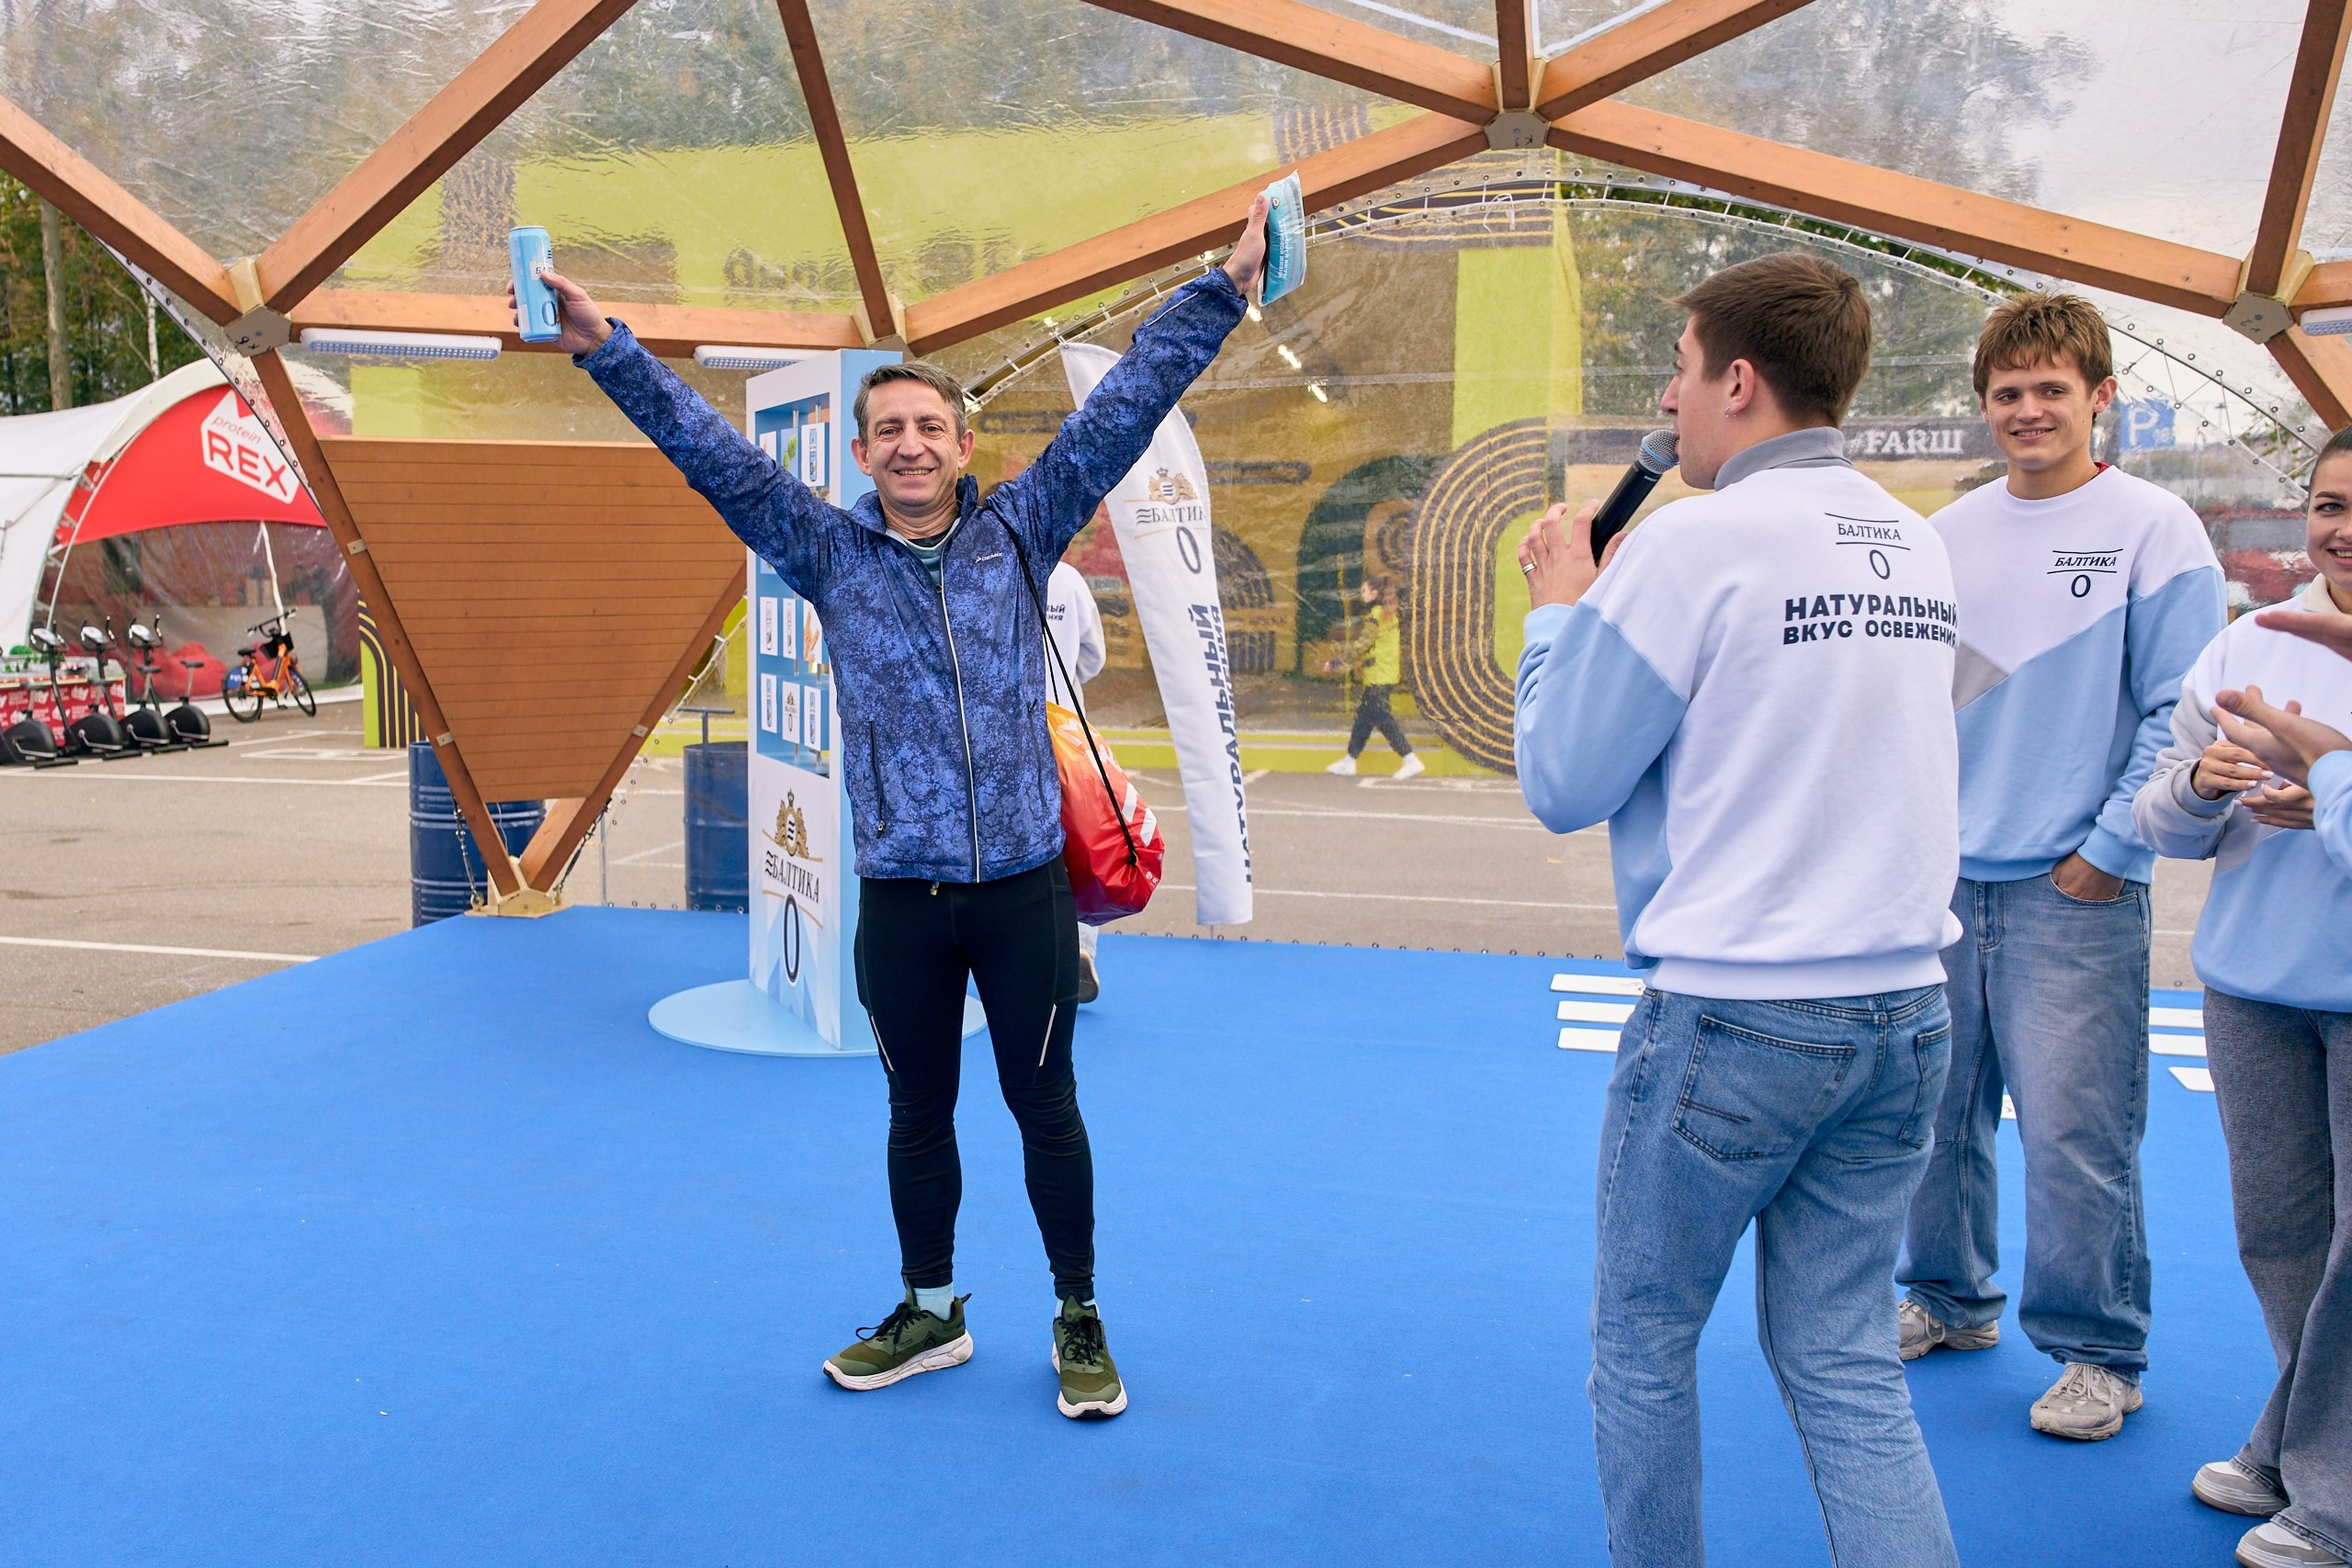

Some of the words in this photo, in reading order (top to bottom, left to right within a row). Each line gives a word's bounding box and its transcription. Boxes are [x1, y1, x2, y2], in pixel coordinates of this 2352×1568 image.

[211, 416, 261, 445] protein
[208, 430, 288, 497] REX
[1838, 523, 1902, 541] БАЛТИКА
[2054, 557, 2117, 567] БАЛТИКА
[1785, 594, 1958, 629] НАТУРАЛЬНЫЙ
[1783, 620, 1853, 645] ВКУС
[773, 854, 820, 904] БАЛТИКА
